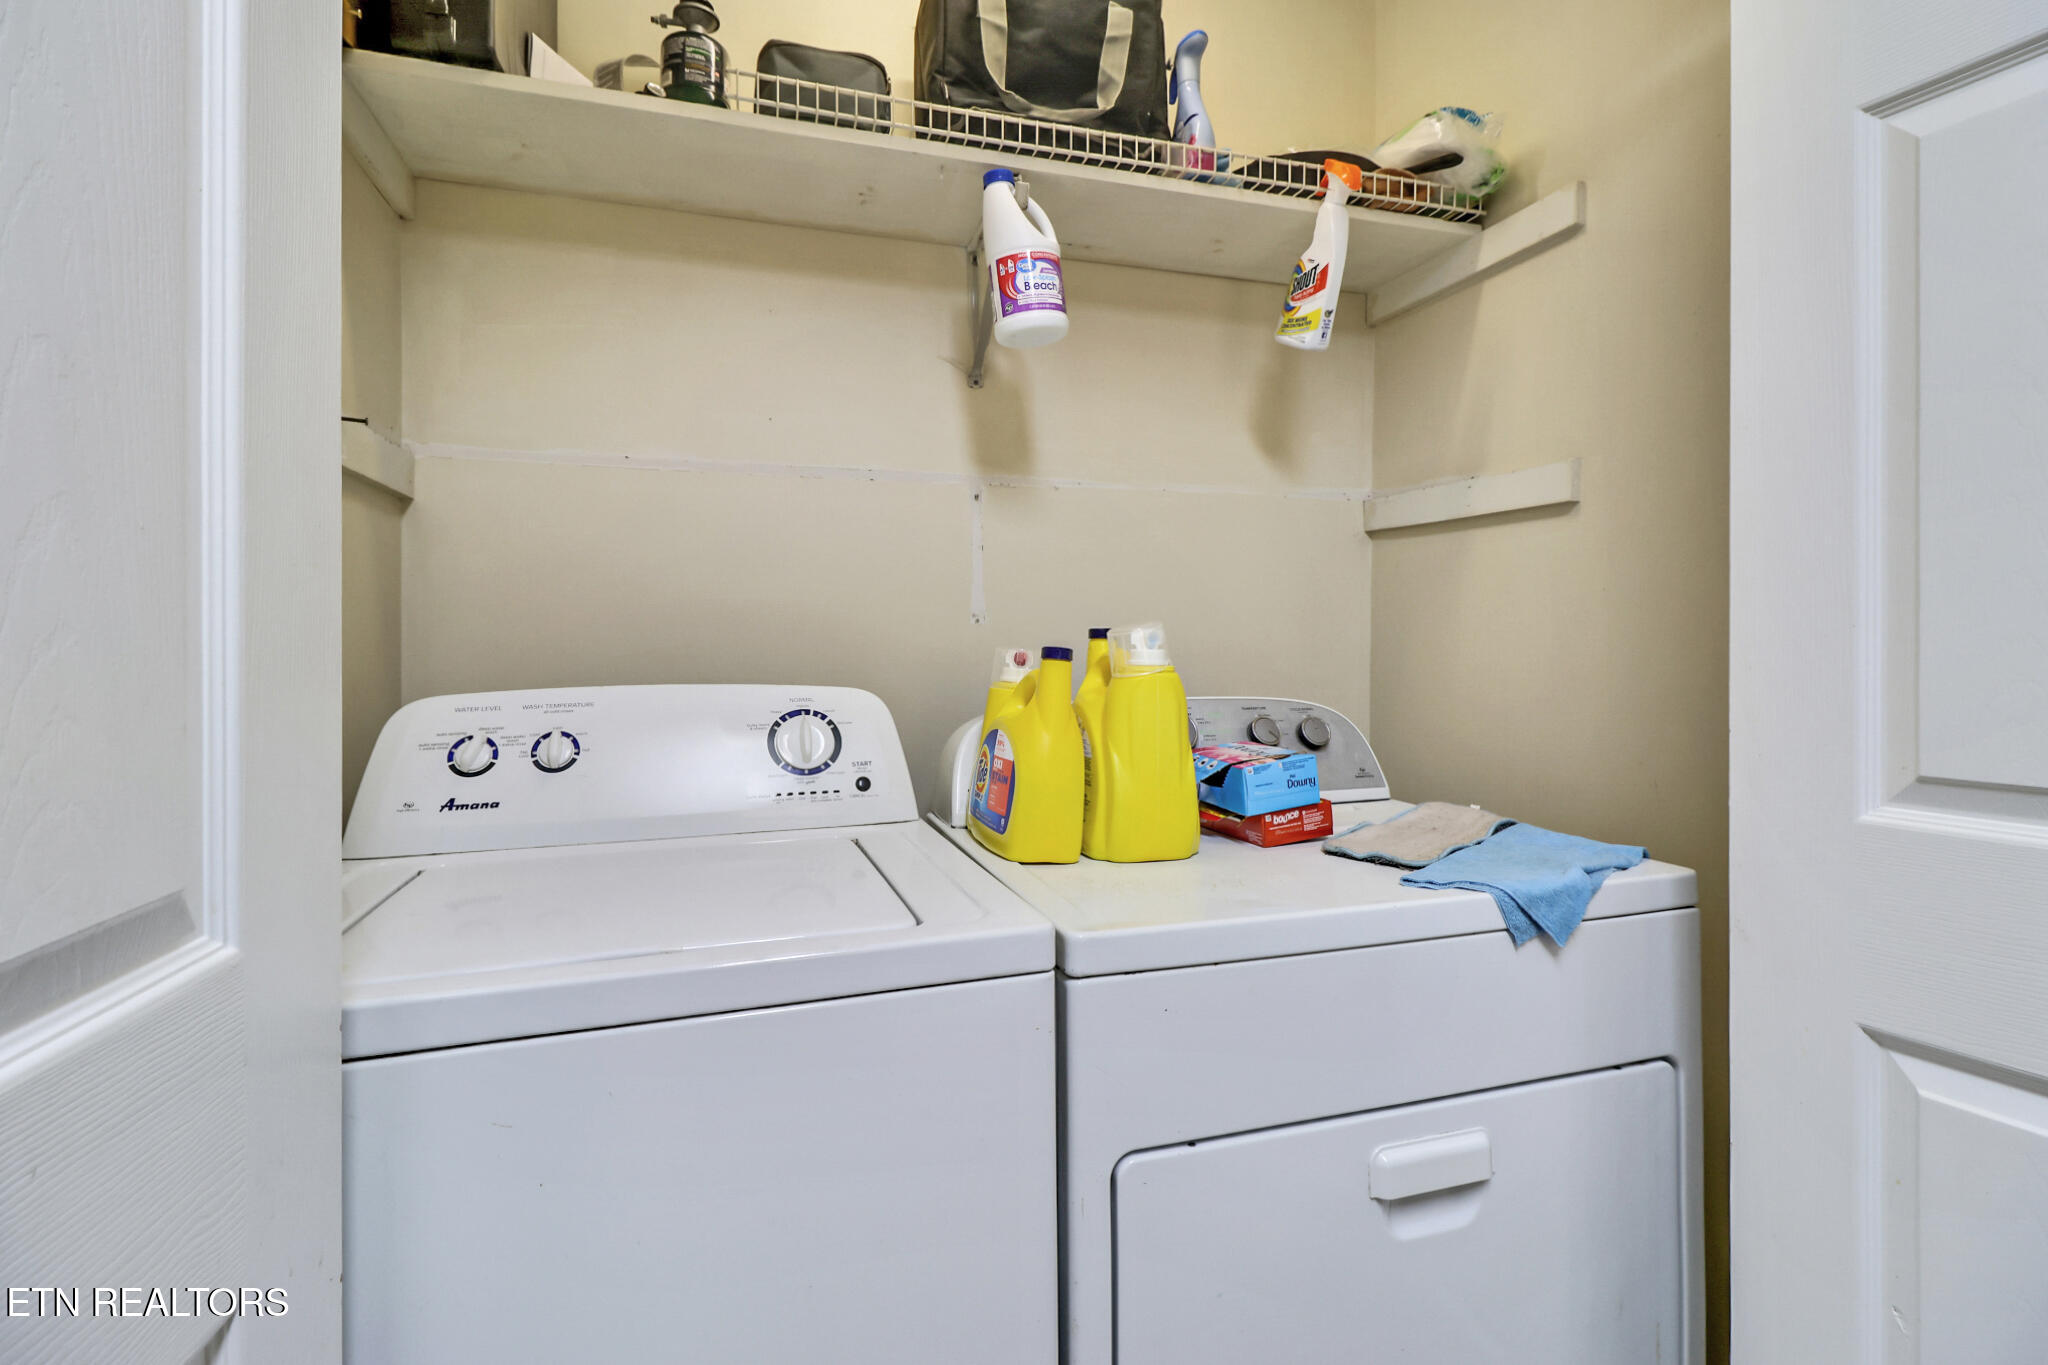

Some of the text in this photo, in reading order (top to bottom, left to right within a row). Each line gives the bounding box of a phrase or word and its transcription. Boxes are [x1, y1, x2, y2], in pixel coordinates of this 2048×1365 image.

[1024, 281, 1058, 291] Beach
[851, 760, 873, 768] START
[1287, 776, 1316, 790] Downy
[439, 797, 500, 812] Amana
[1273, 810, 1300, 825] bounce
